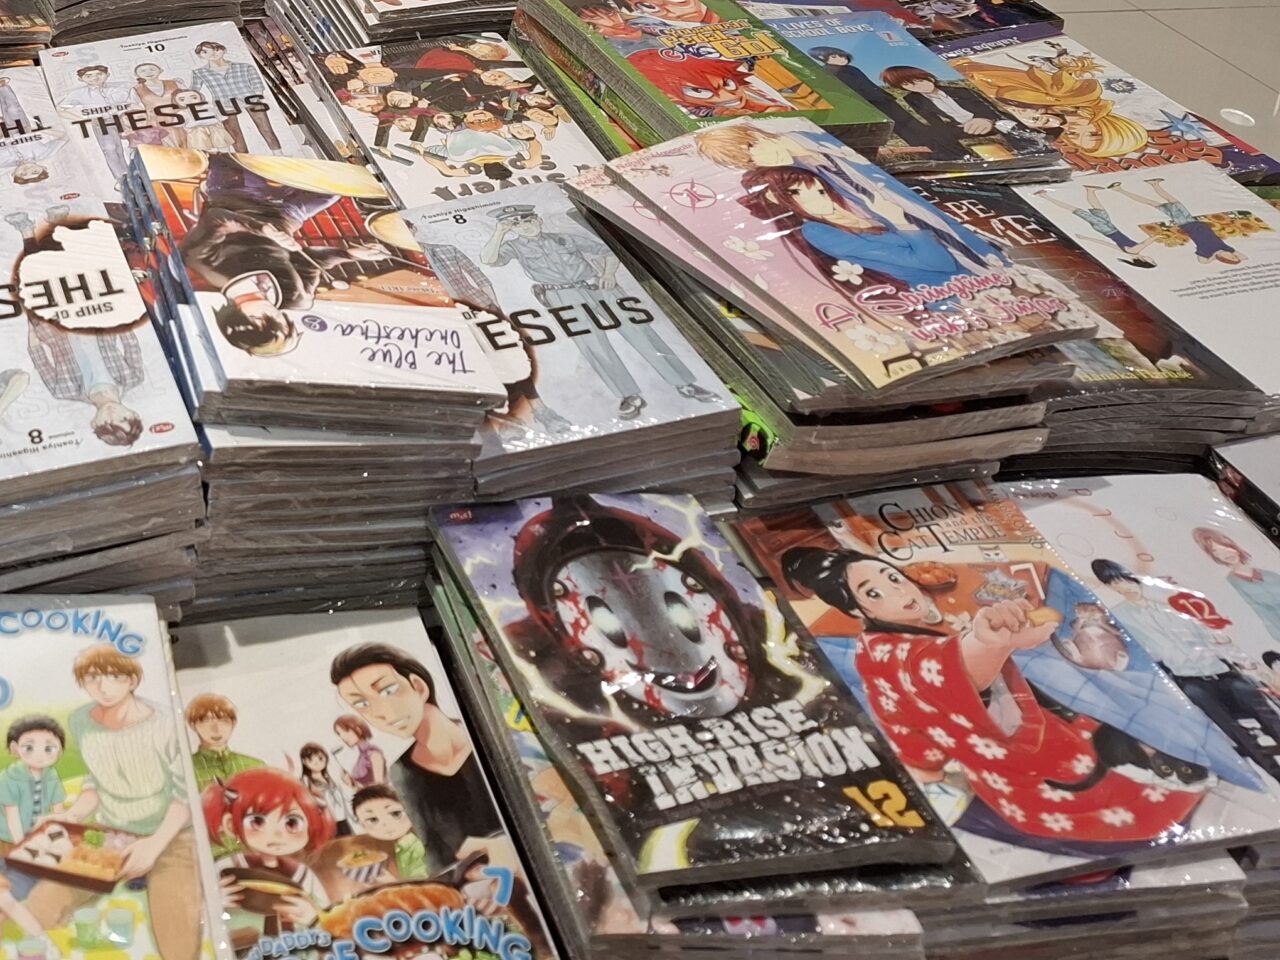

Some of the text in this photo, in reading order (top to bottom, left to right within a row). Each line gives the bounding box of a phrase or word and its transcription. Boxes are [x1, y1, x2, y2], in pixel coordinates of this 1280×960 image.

[780, 23, 875, 39] SCHOOL BOYS
[784, 18, 842, 31] LIVES OF
[145, 43, 166, 54] 10
[72, 93, 271, 140] THESEUS
[81, 103, 132, 117] SHIP OF
[11, 133, 43, 147] SHIP
[452, 213, 468, 226] 8
[855, 271, 1012, 316] Springtime
[51, 301, 114, 322] SHIP OF
[477, 295, 657, 352] ESEUS
[815, 302, 859, 333] A
[333, 320, 461, 352] Orchestra
[360, 342, 475, 375] The Blue
[26, 428, 44, 445] 8
[878, 501, 965, 532] CHION
[945, 513, 994, 528] and the
[877, 522, 1007, 561] CAT TEMPLE
[1010, 562, 1046, 601] 7
[577, 700, 818, 777] HIGH-RISE
[639, 725, 882, 811] INVASION
[842, 779, 927, 829] 12
[483, 866, 514, 908] 7
[352, 905, 533, 960] COOKING
